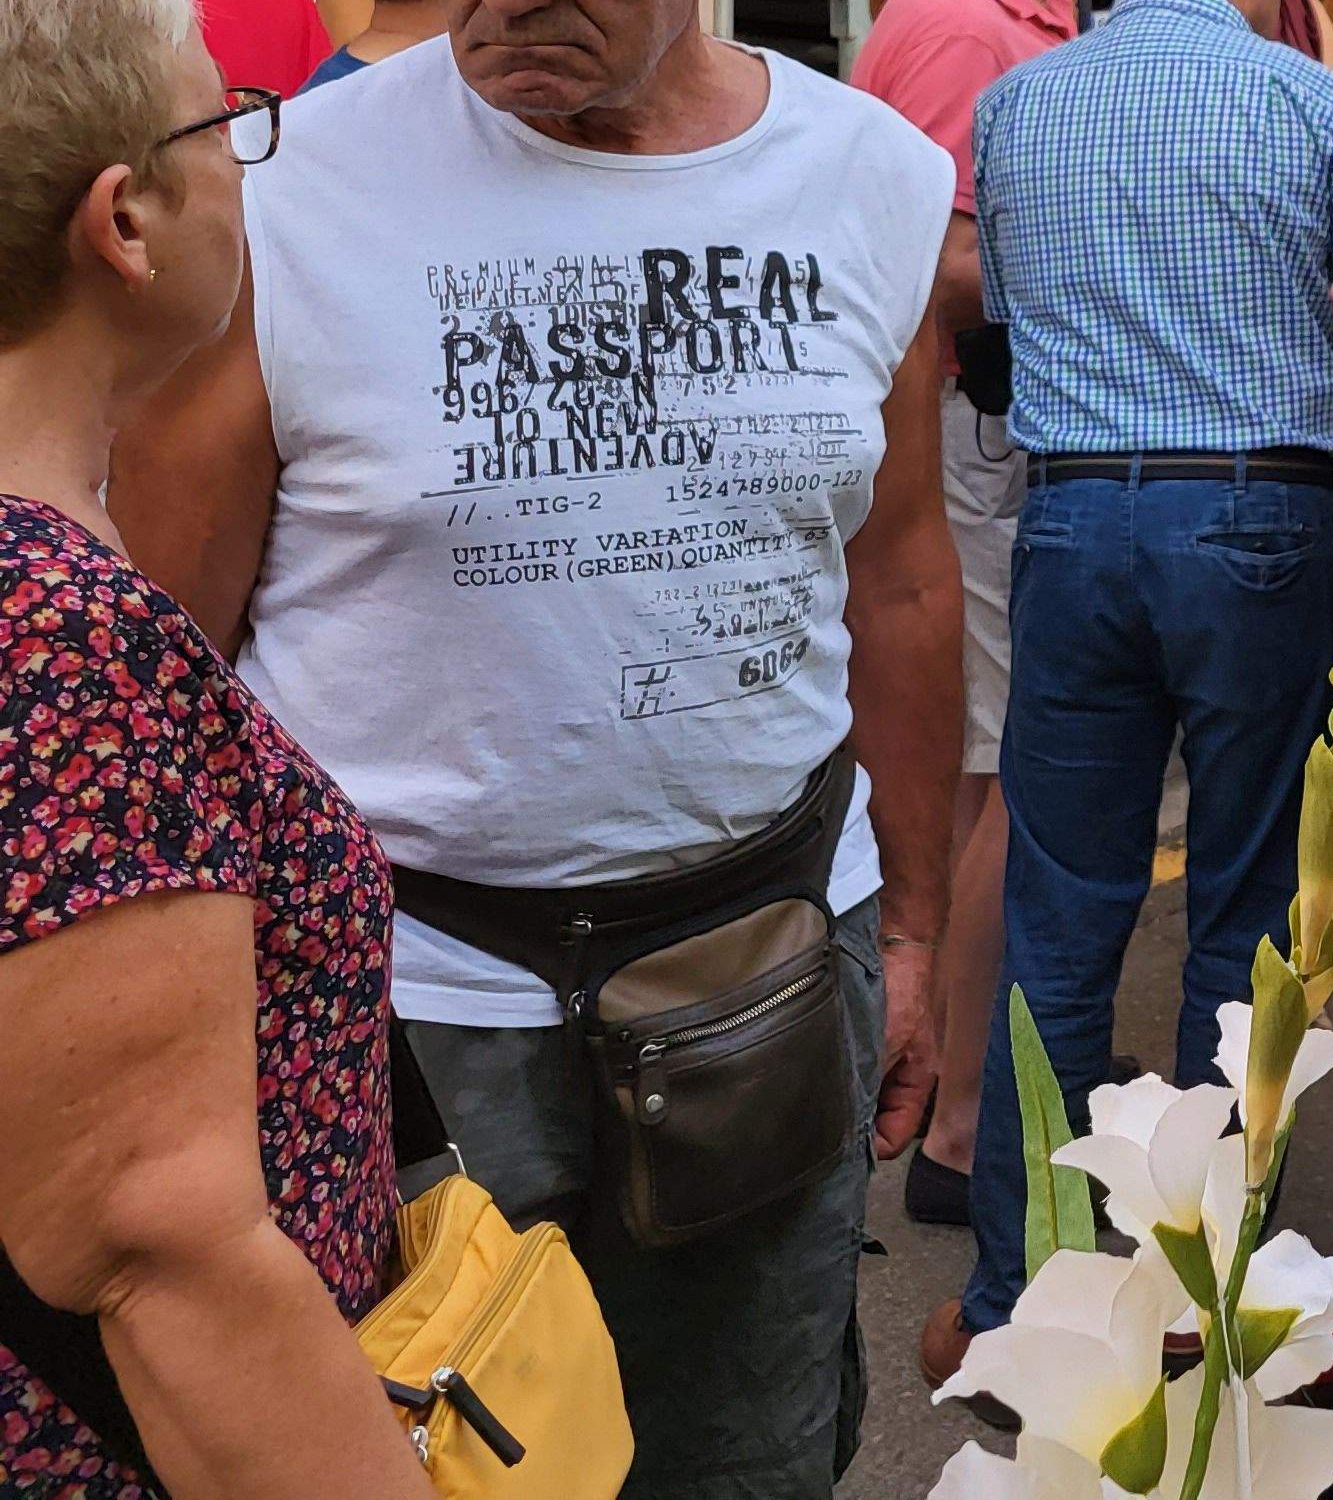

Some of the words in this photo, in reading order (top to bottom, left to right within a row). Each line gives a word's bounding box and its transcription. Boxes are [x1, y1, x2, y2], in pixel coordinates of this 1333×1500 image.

[642, 245, 840, 323] REAL
[442, 318, 801, 385] PASSPORT
[453, 418, 717, 485] ADVENTURE
[565, 399, 657, 439] NEW
[453, 537, 578, 566] UTILITY
[595, 518, 749, 552] VARIATION
